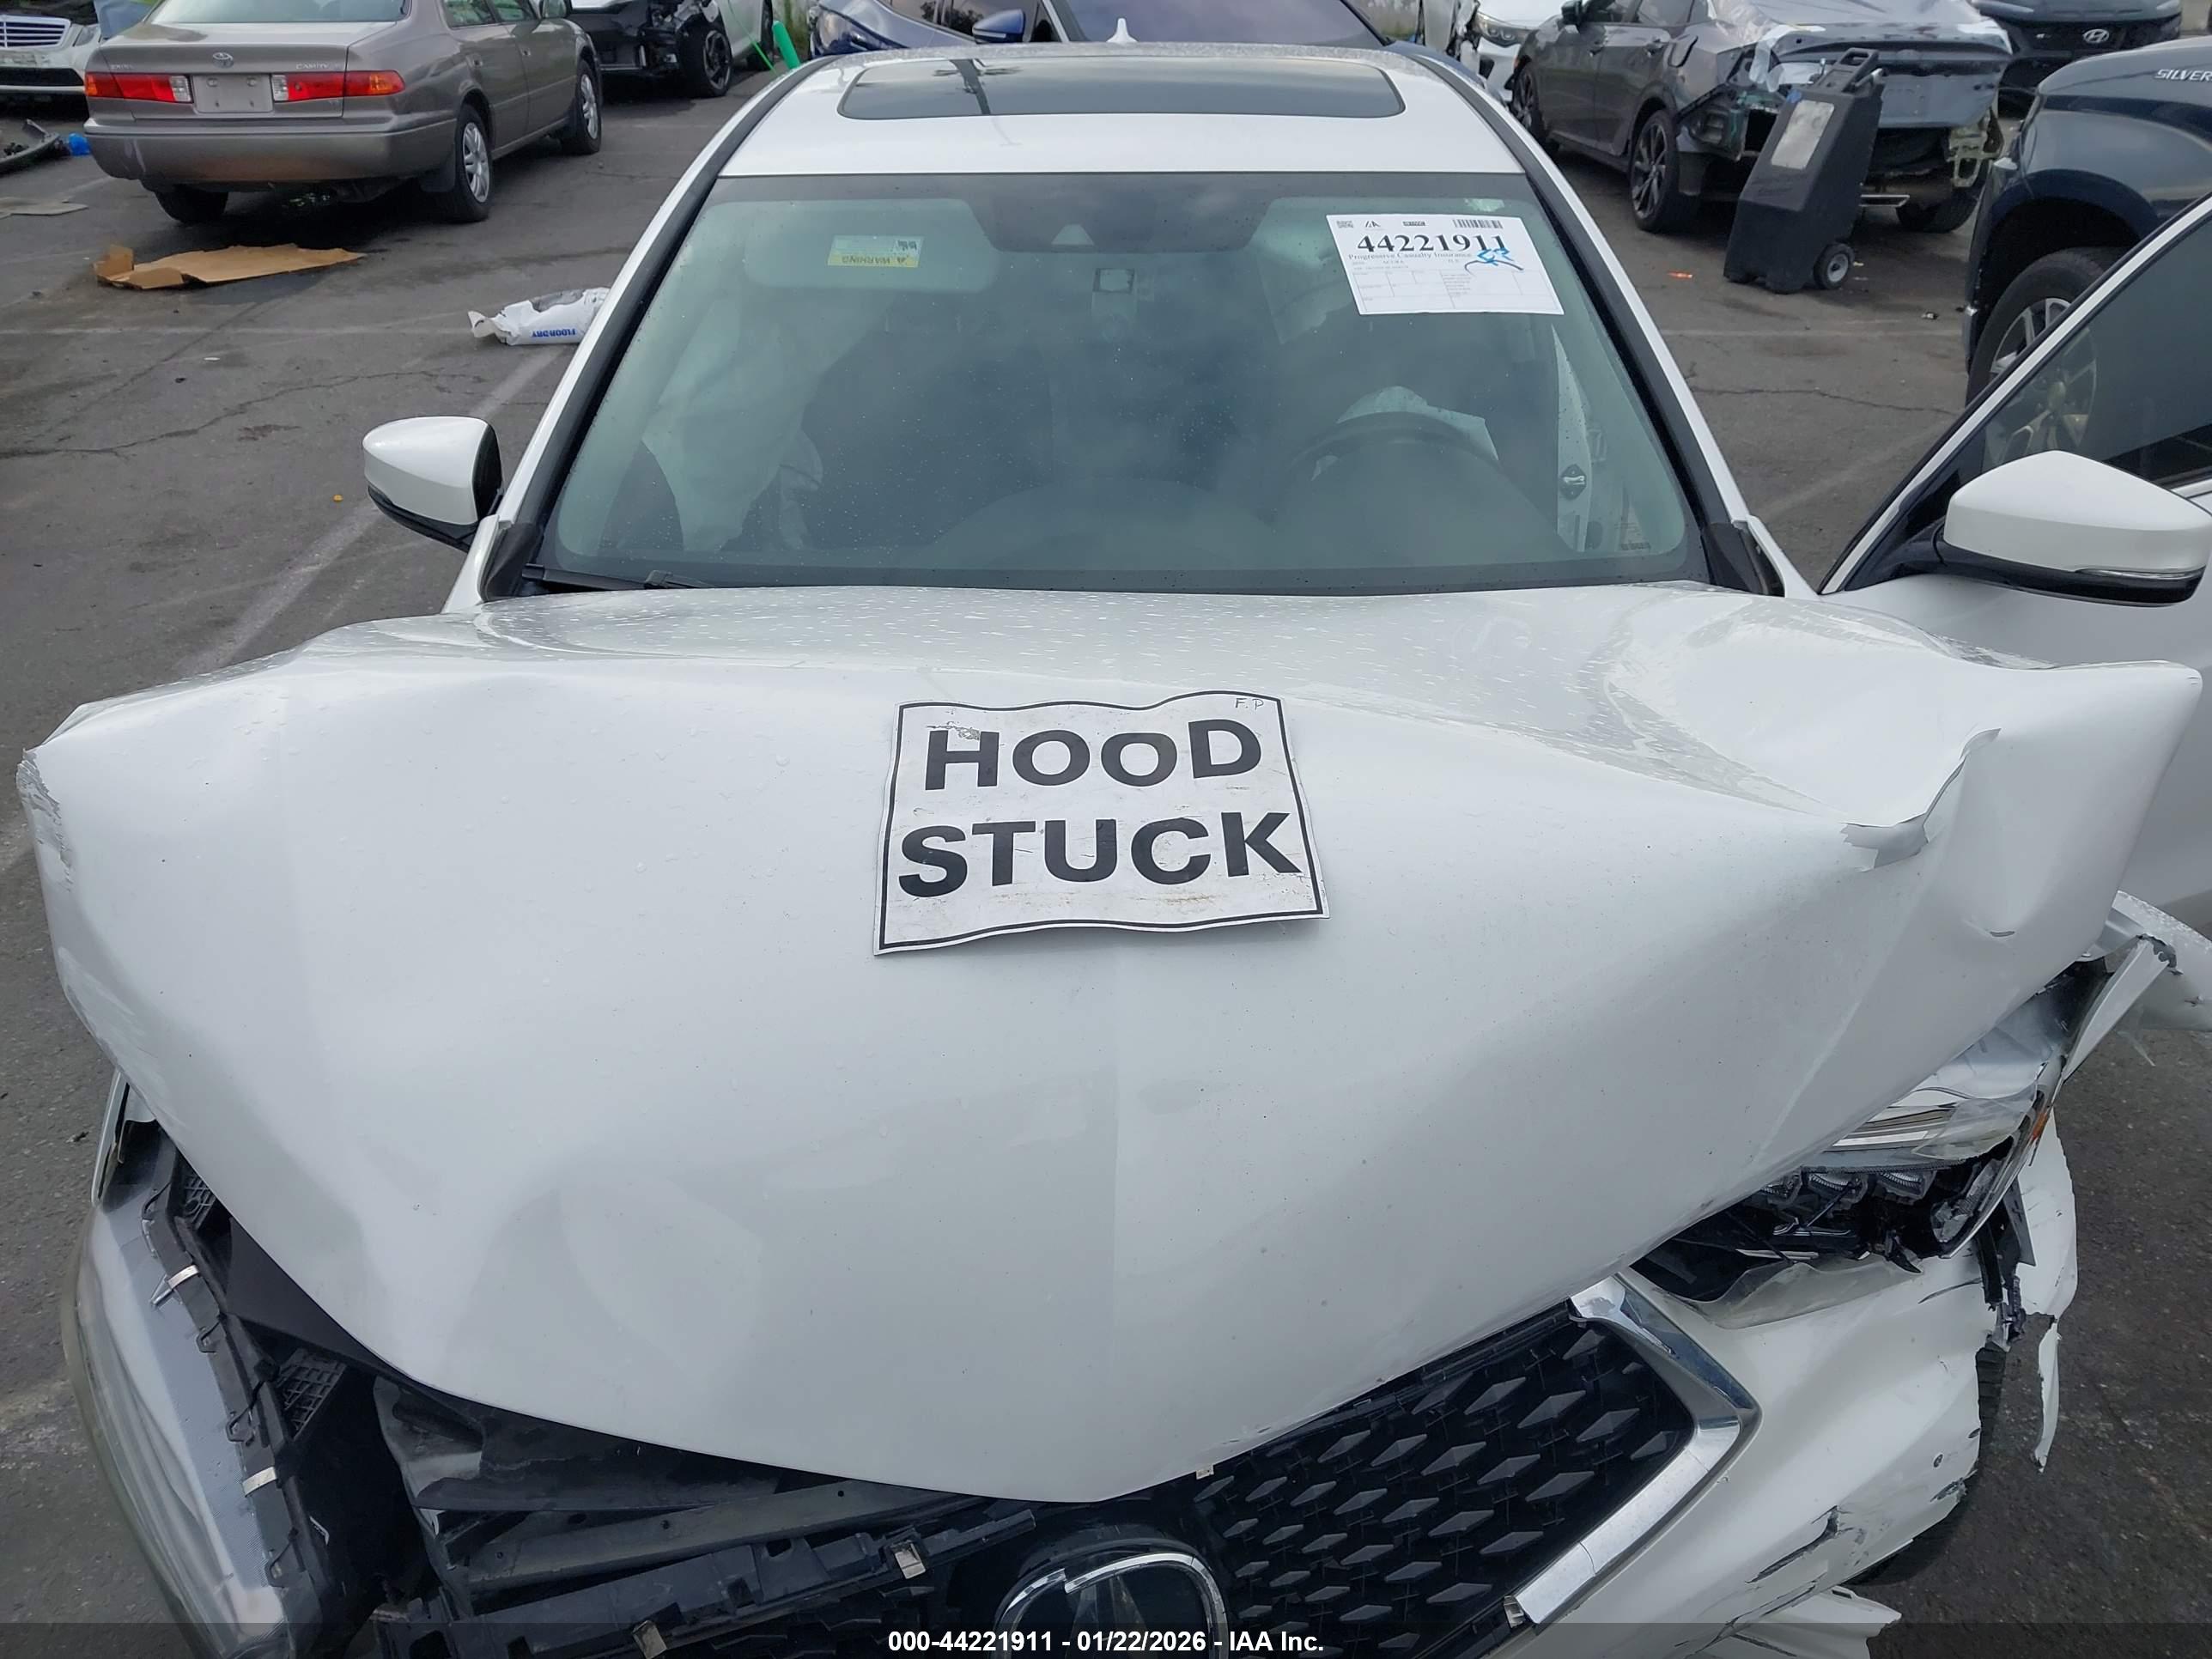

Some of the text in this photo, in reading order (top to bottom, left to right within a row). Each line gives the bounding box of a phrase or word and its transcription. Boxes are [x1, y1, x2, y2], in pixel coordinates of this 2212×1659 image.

[2154, 68, 2212, 82] SILVER
[1357, 234, 1507, 252] 44221911
[925, 719, 1261, 791] HOOD
[897, 811, 1304, 898] STUCK
